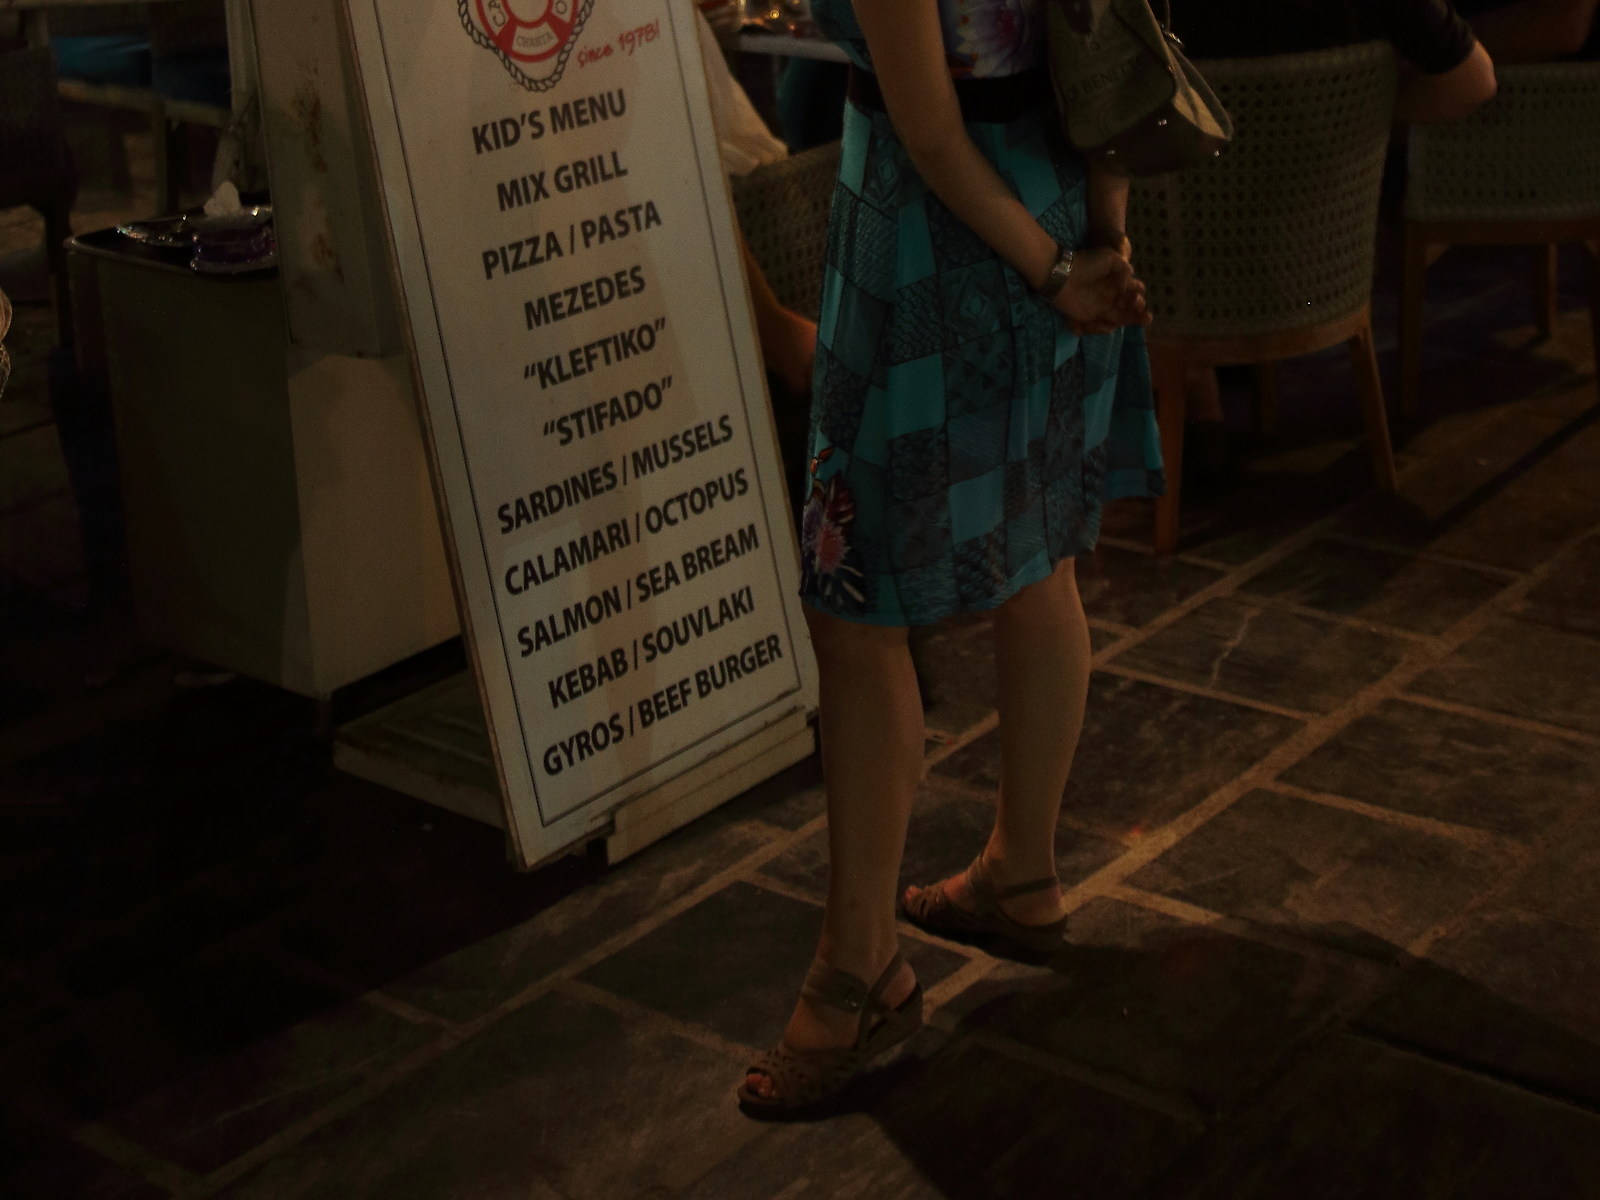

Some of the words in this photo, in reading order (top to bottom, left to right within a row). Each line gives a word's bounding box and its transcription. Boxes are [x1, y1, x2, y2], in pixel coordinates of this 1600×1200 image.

[472, 110, 546, 154] KID'S
[549, 88, 627, 135] MENU
[497, 171, 550, 211] MIX
[553, 151, 628, 194] GRILL
[481, 231, 564, 280] PIZZA
[580, 201, 662, 248] PASTA
[524, 265, 646, 330] MEZEDES
[497, 461, 618, 534] SARDINES
[631, 414, 733, 479] MUSSELS
[504, 518, 631, 596] CALAMARI
[645, 468, 749, 534] OCTOPUS
[517, 585, 622, 658] SALMON
[635, 561, 681, 603] SEA
[681, 523, 760, 581] BREAM
[548, 647, 629, 709] KEBAB
[642, 585, 755, 663] SOUVLAKI
[543, 713, 625, 776] GYROS
[637, 677, 693, 730] BEEF
[694, 634, 783, 699] BURGER
